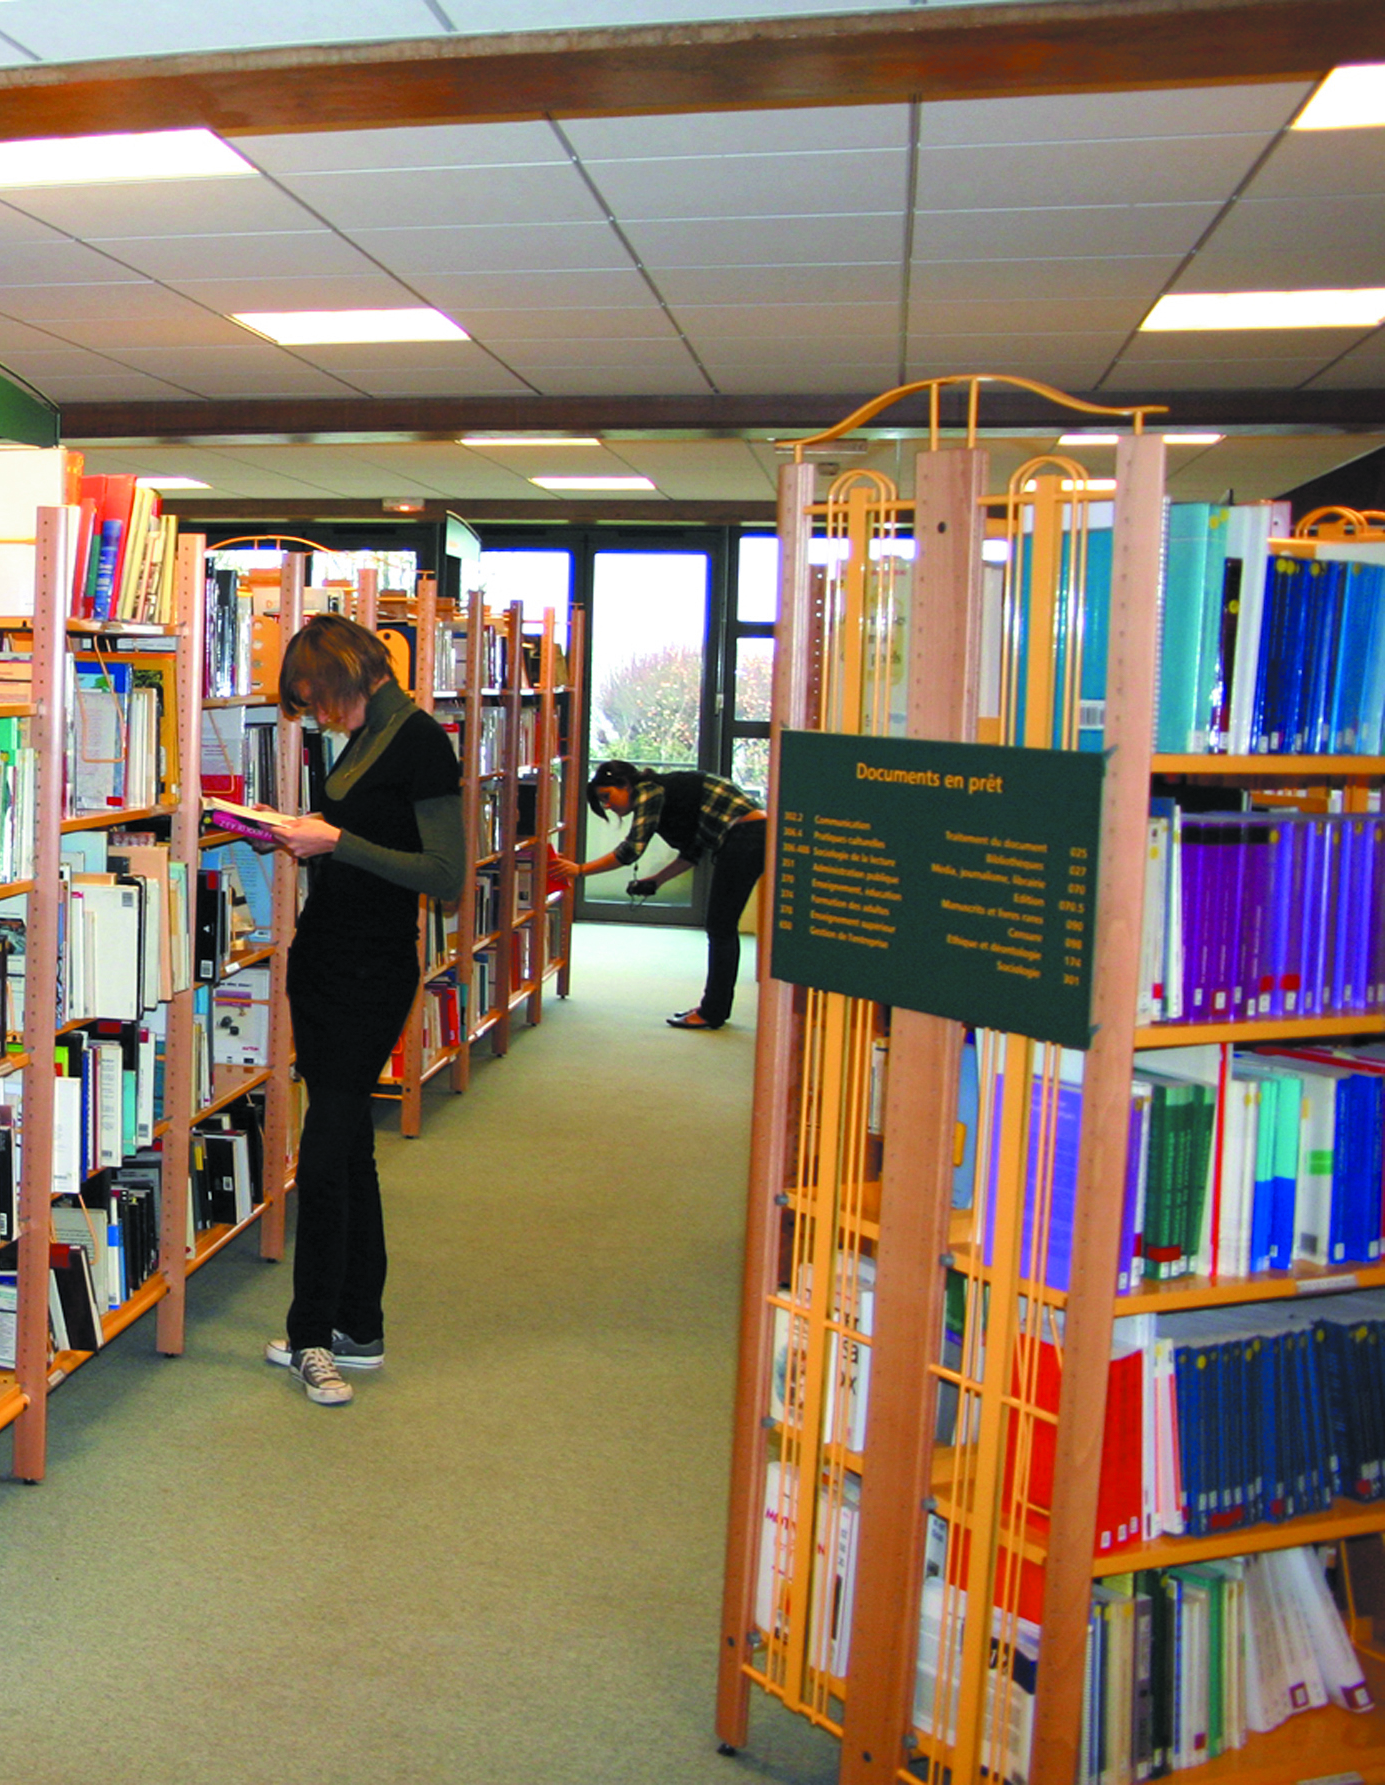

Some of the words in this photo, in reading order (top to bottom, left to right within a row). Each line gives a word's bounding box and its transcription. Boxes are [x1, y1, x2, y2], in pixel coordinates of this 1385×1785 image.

[856, 762, 941, 787] Documents
[945, 773, 964, 789] en
[969, 774, 1003, 795] prêt
[1004, 838, 1048, 853] document
